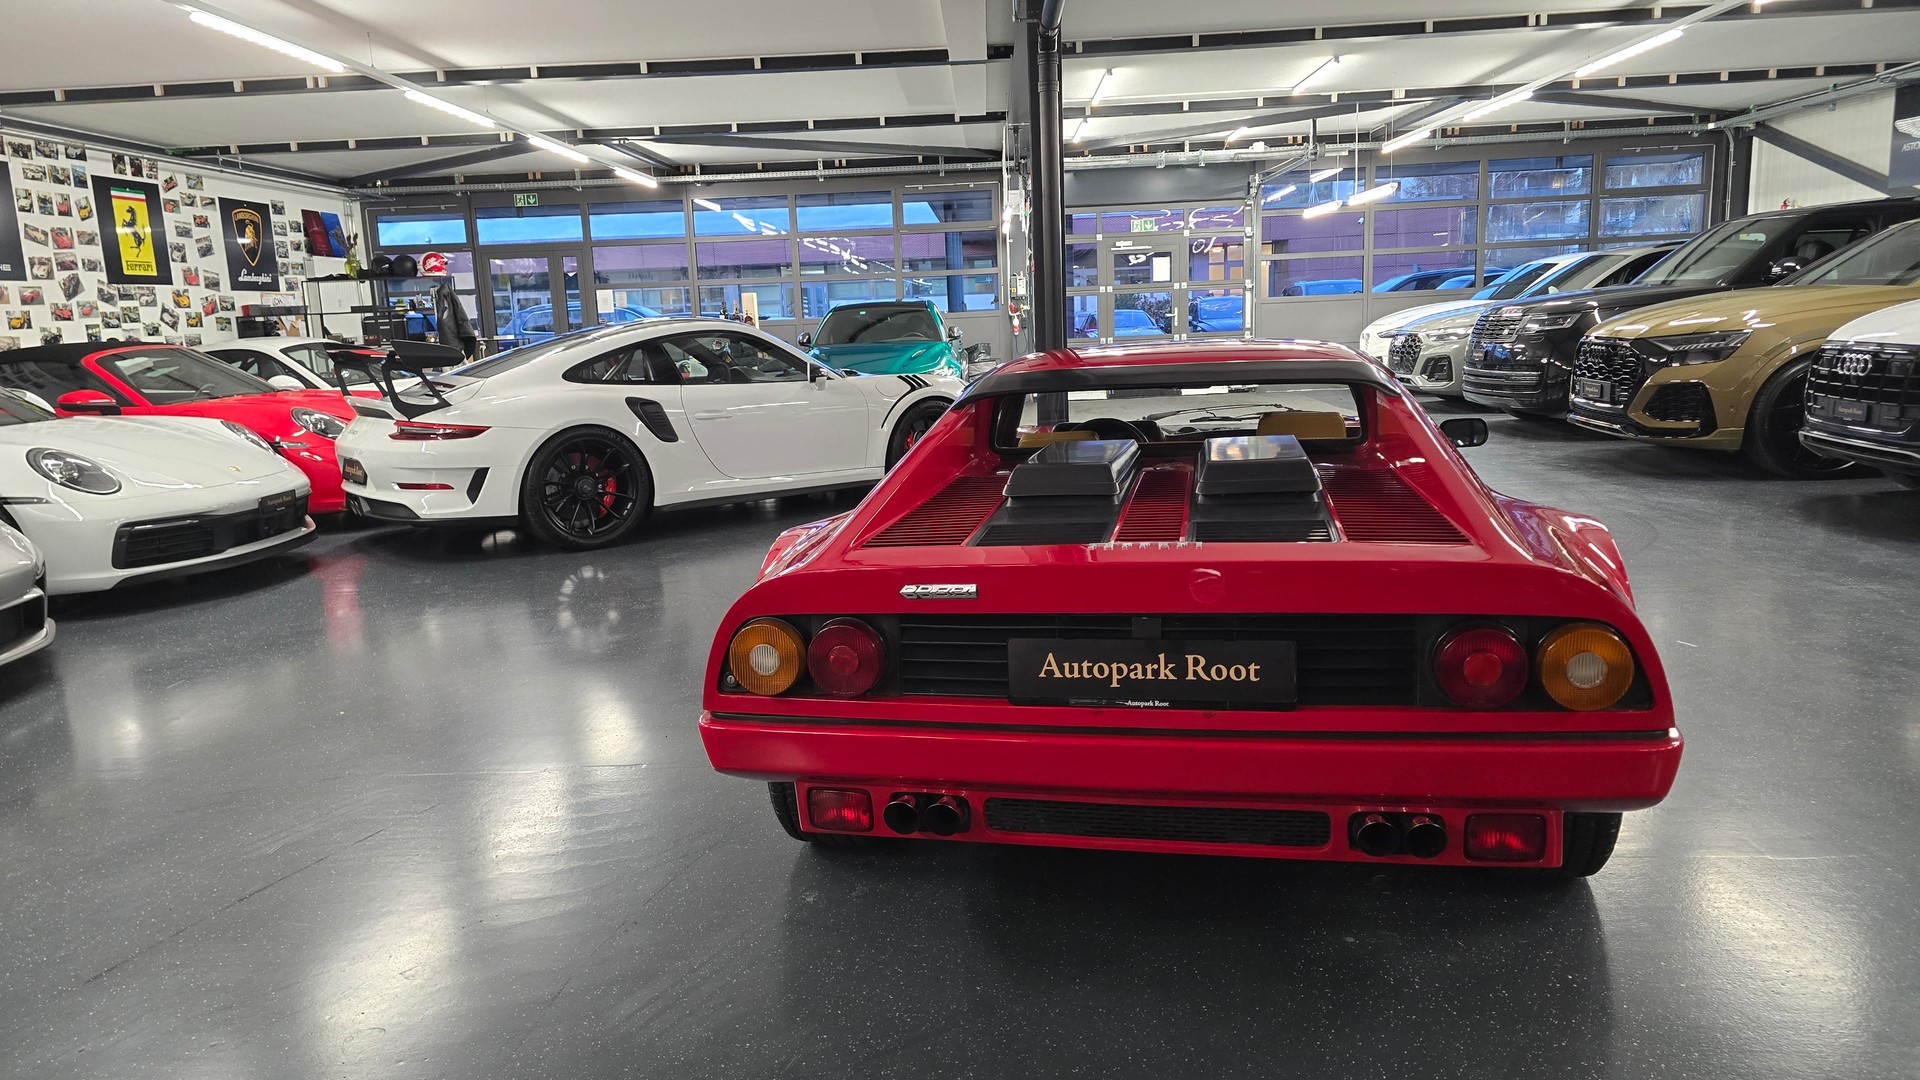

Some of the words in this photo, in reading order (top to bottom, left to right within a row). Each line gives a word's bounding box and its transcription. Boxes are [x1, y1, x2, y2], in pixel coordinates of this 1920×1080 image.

[126, 260, 153, 271] Ferrari
[1038, 652, 1178, 688] Autopark
[1185, 654, 1261, 682] Root
[1127, 700, 1154, 708] Autopark
